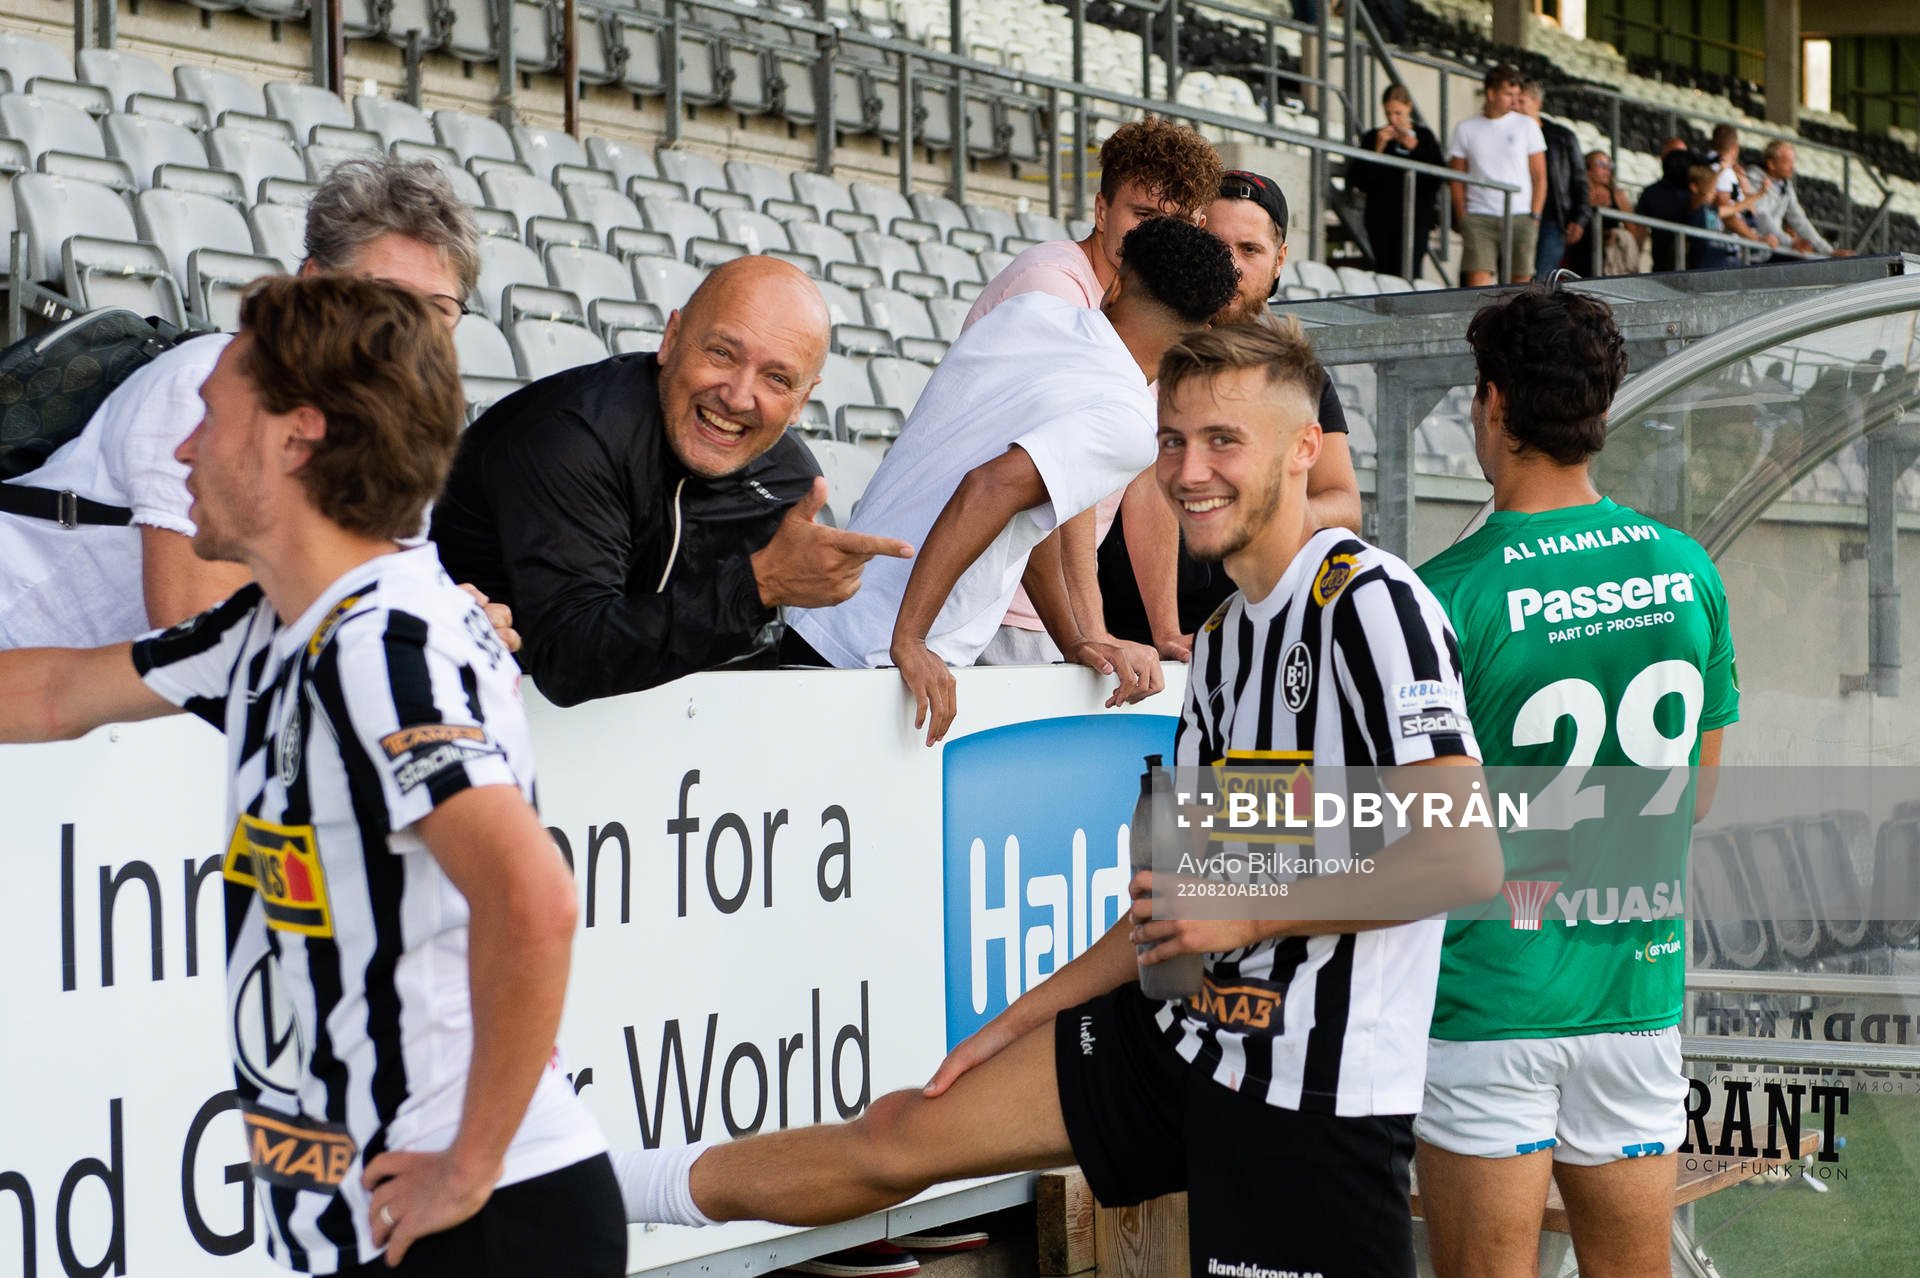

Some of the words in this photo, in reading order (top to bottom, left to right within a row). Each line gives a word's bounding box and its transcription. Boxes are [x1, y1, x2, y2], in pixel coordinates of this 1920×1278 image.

[1504, 543, 1537, 564] AL
[1537, 525, 1661, 556] HAMLAWI
[1507, 572, 1695, 632] Passera
[1548, 626, 1582, 644] PART
[1585, 622, 1603, 636] OF
[1607, 611, 1676, 632] PROSERO
[1506, 659, 1705, 834] 29
[667, 768, 788, 918] for
[816, 804, 852, 902] a
[623, 980, 872, 1151] World
[1685, 1158, 1728, 1173] OCH
[1740, 1161, 1849, 1181] FUNKTION
